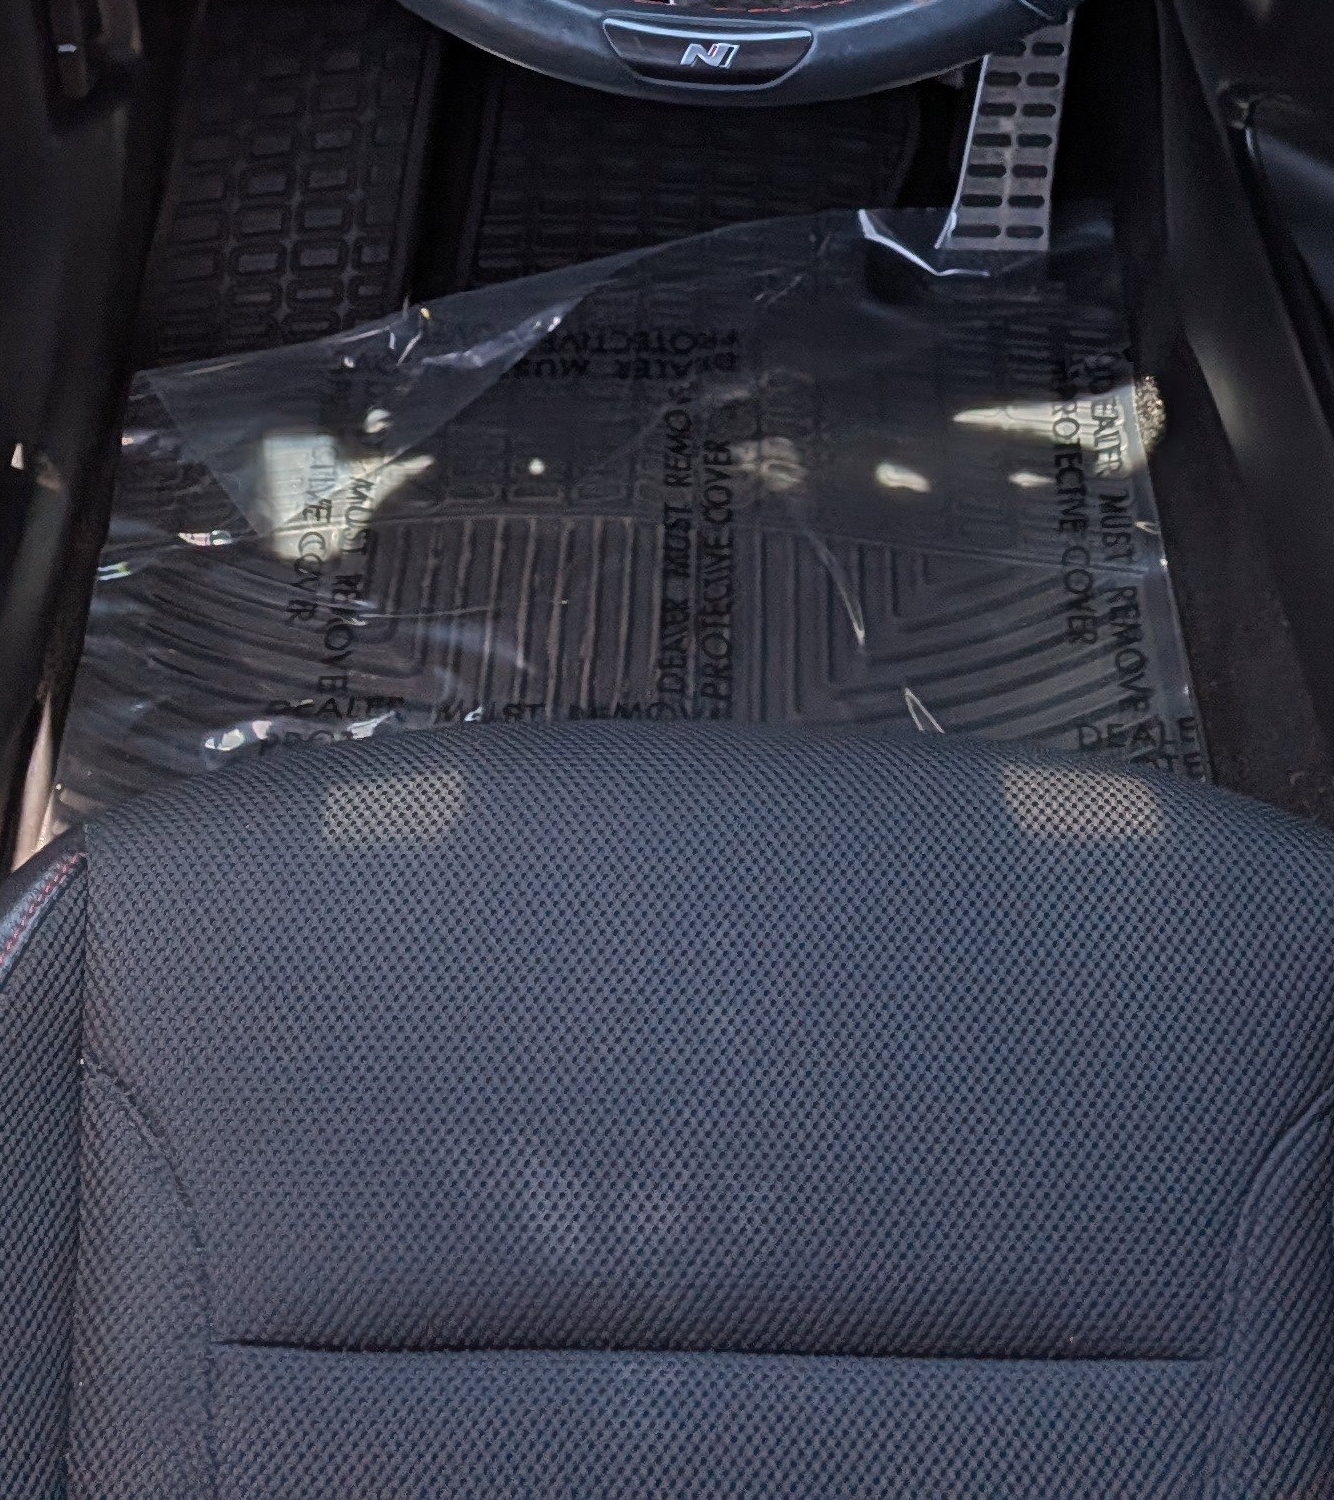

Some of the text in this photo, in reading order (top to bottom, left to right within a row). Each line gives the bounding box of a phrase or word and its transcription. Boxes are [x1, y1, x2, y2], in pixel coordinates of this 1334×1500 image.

[703, 440, 733, 525] COVER
[1098, 492, 1135, 563] MUST
[1060, 546, 1098, 645] COVER
